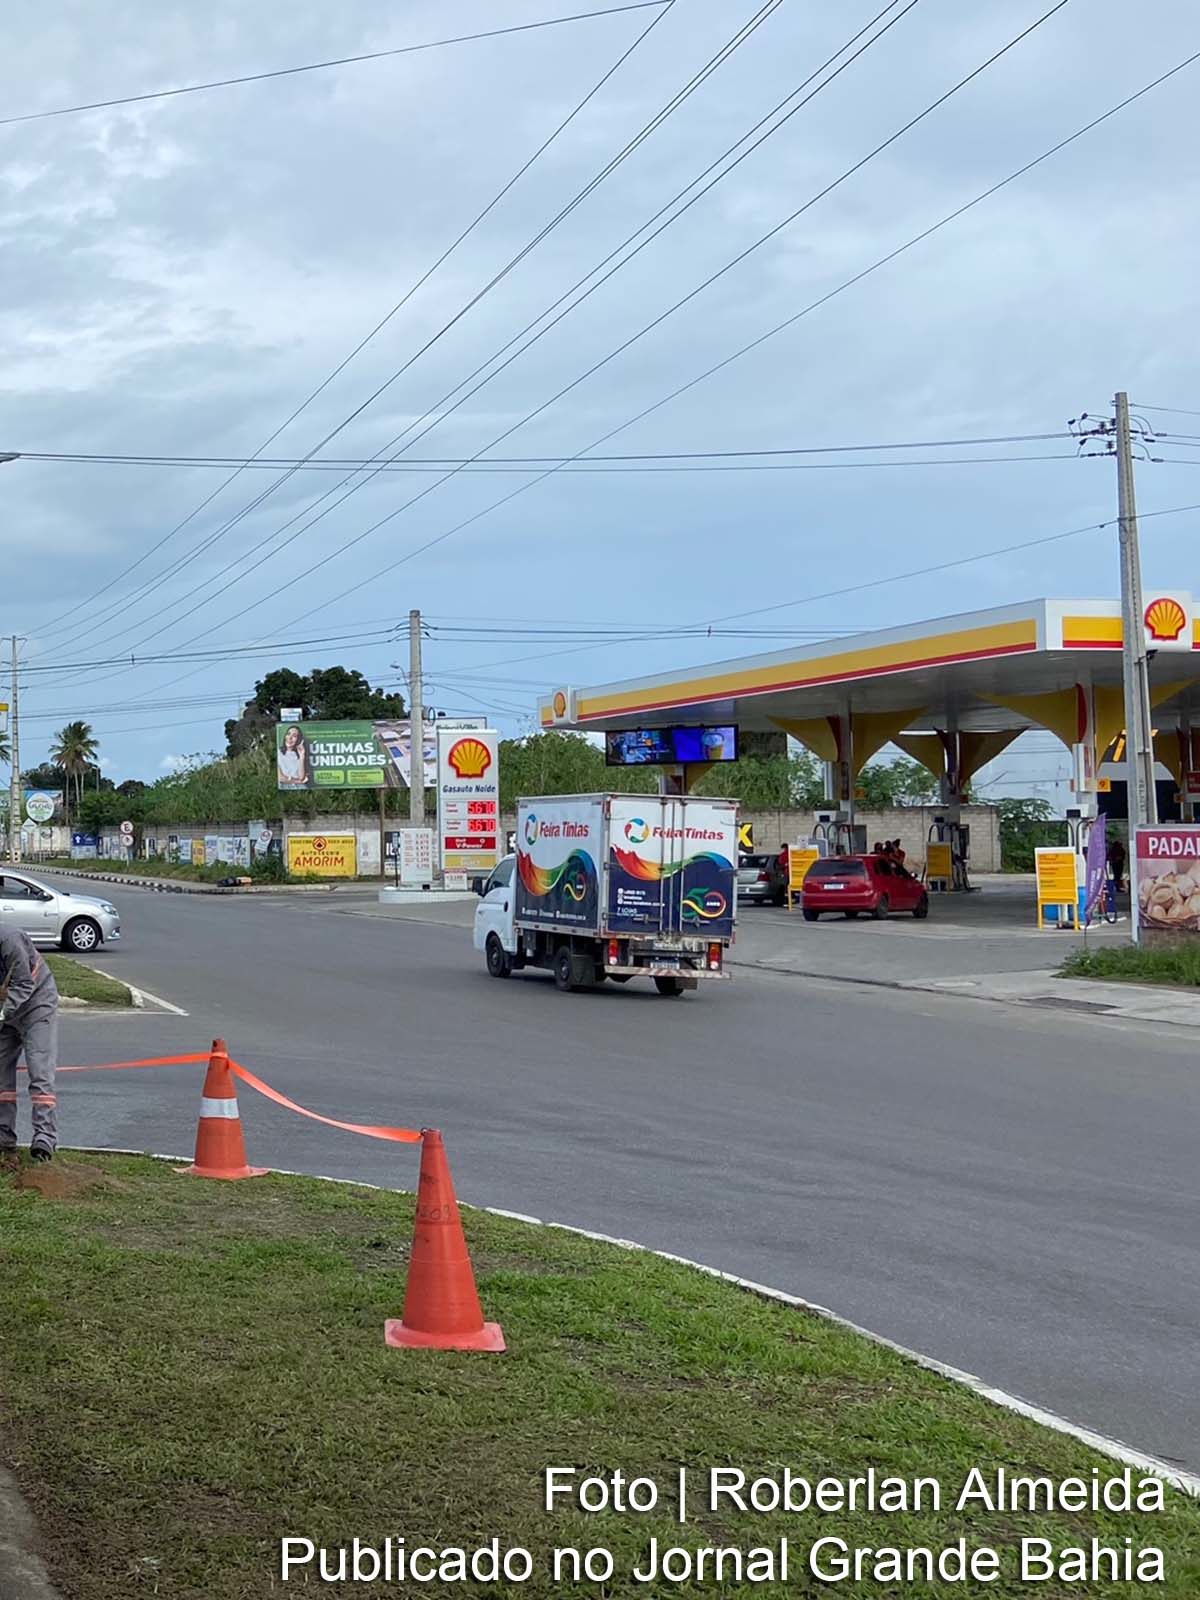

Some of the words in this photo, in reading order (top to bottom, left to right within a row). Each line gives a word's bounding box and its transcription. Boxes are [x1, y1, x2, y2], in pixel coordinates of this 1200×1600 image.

[309, 740, 374, 754] ÚLTIMAS
[309, 754, 386, 767] UNIDADES
[442, 784, 473, 793] Gasauto
[539, 822, 560, 837] Feira
[562, 821, 589, 837] Tintas
[652, 826, 682, 838] Feira
[684, 827, 724, 840] Tintas
[1148, 836, 1200, 856] PADA
[294, 856, 344, 867] AMORIM
